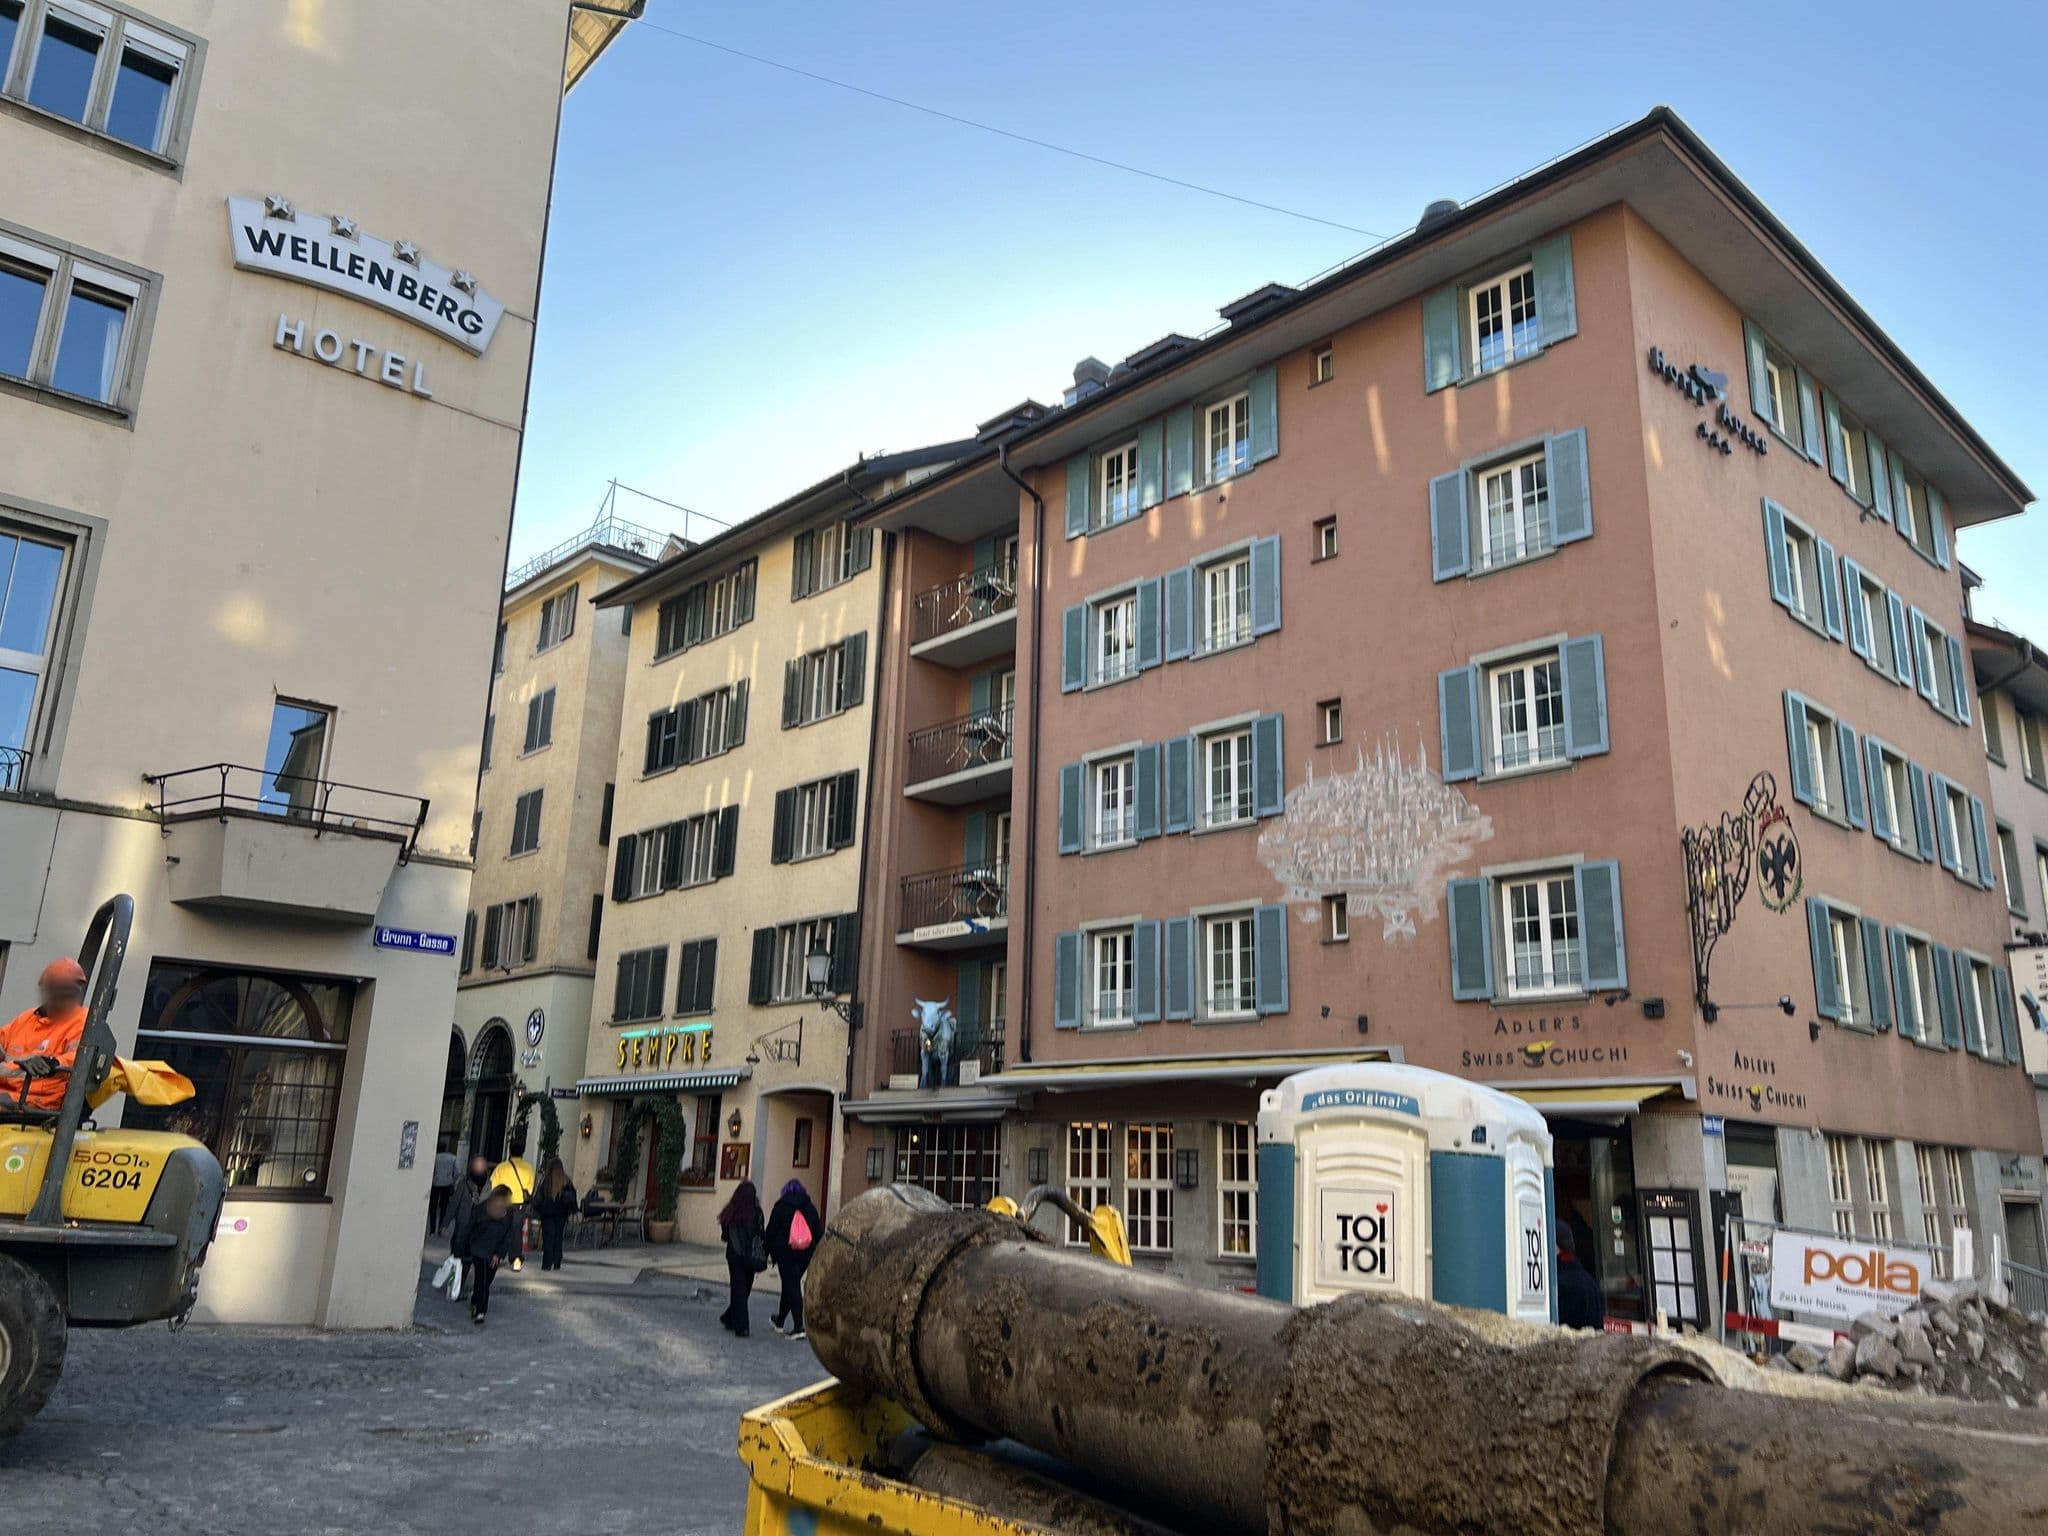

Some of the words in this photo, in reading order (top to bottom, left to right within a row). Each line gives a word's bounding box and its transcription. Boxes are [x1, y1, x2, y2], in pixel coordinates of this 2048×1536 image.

[244, 225, 483, 335] WELLENBERG
[273, 313, 433, 398] HOTEL
[617, 1029, 712, 1068] SEMPRE
[81, 1168, 142, 1190] 6204
[1336, 1244, 1386, 1274] TOI
[1527, 1259, 1543, 1290] TOI
[1803, 1247, 1919, 1297] polla
